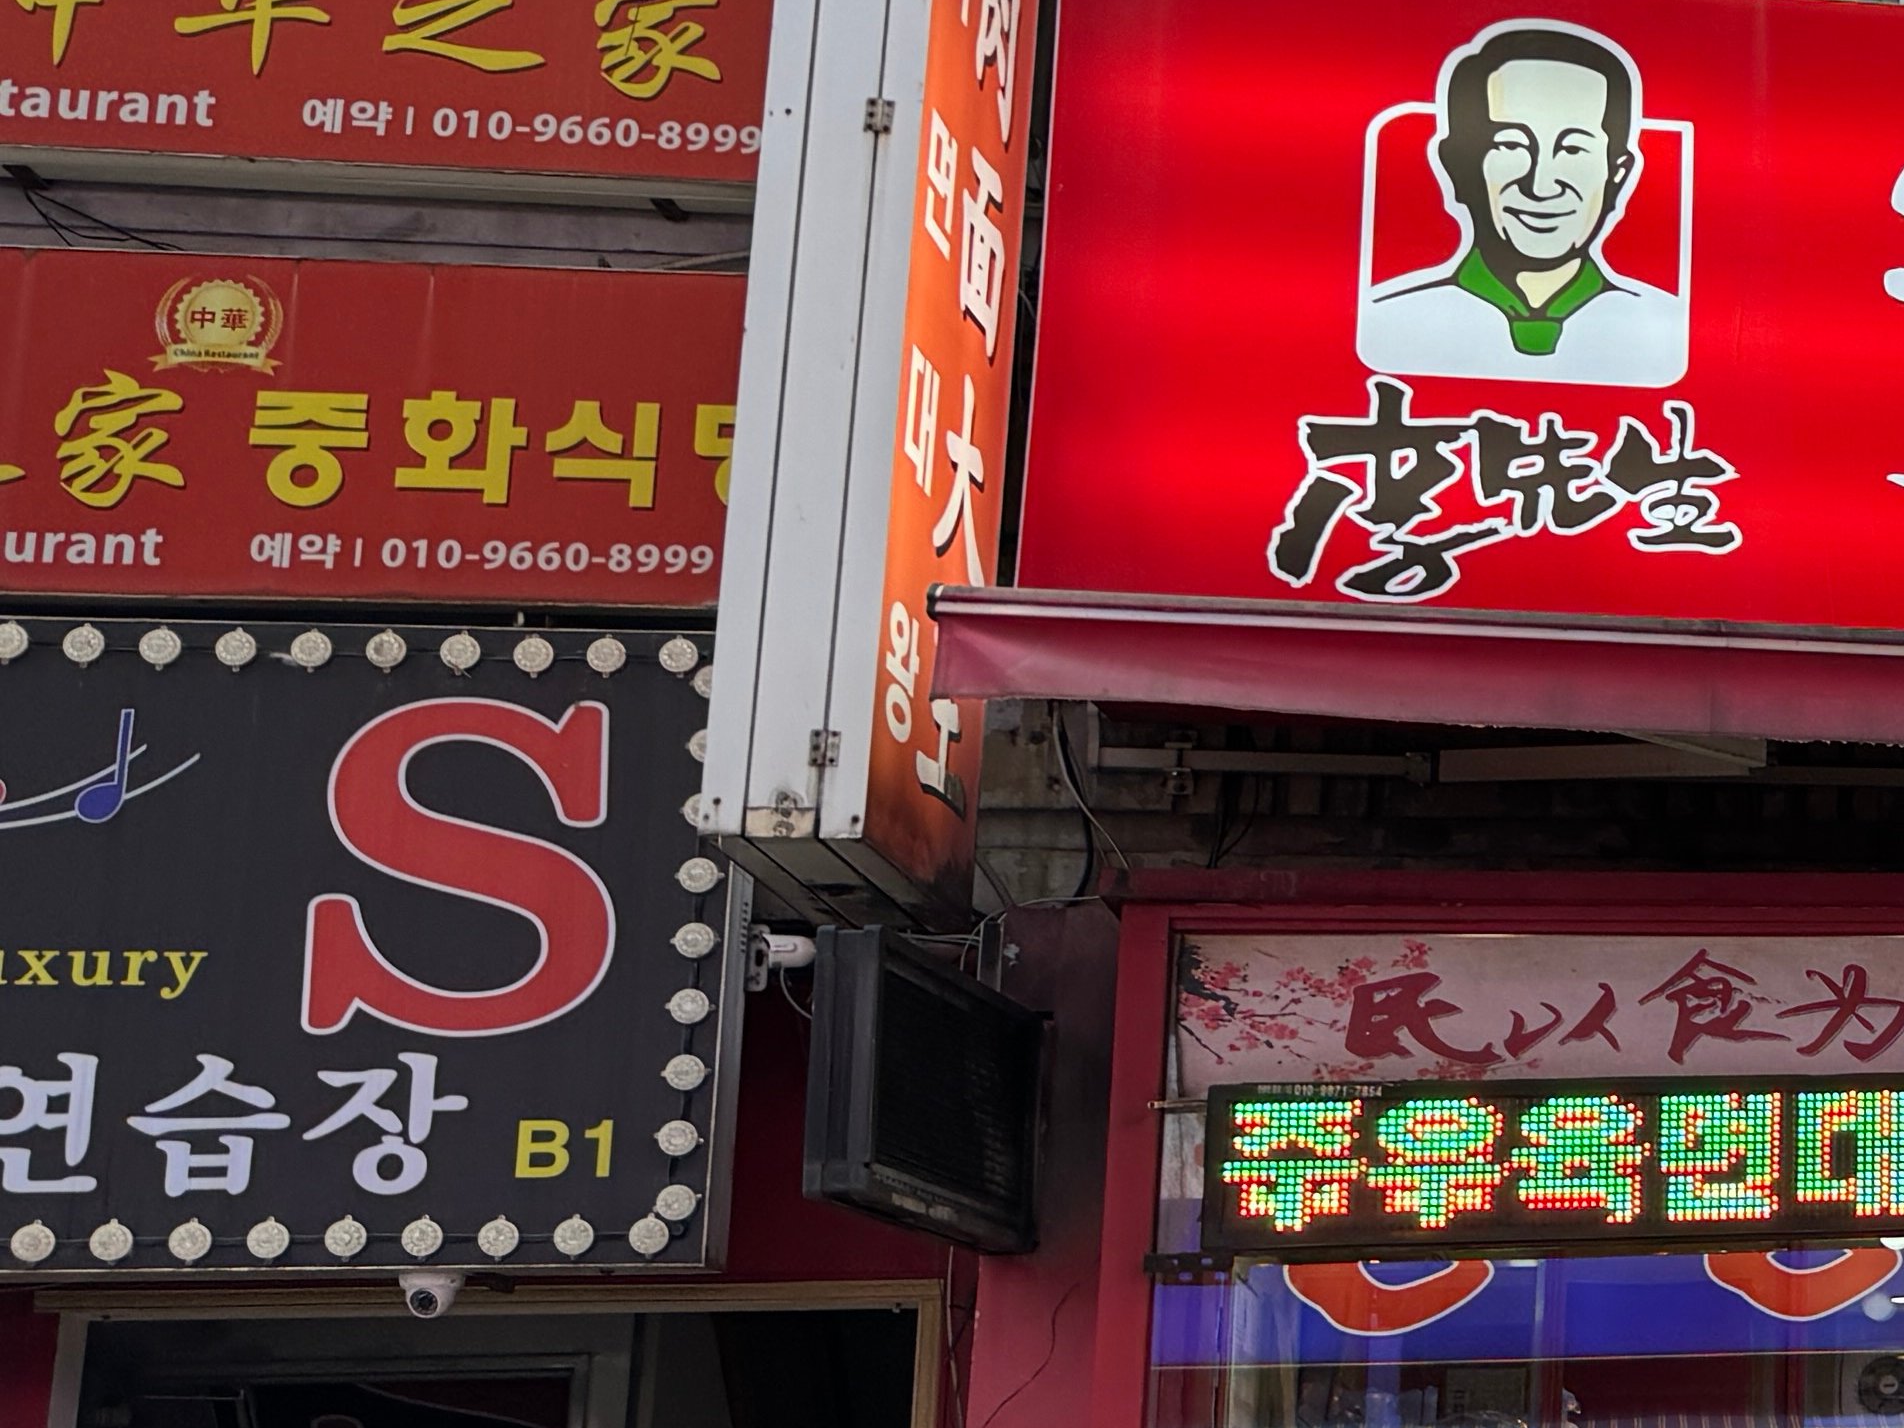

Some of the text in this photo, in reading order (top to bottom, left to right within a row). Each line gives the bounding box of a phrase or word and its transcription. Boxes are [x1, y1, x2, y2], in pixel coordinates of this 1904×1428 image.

[0, 77, 217, 128] taurant
[301, 96, 763, 155] 예약 010-9660-8999
[189, 305, 249, 334] 中華
[4, 528, 165, 566] urant
[250, 530, 715, 577] 예약 010-9660-8999
[301, 696, 618, 1039] S
[0, 1052, 469, 1199] 연습장
[513, 1119, 617, 1180] B1
